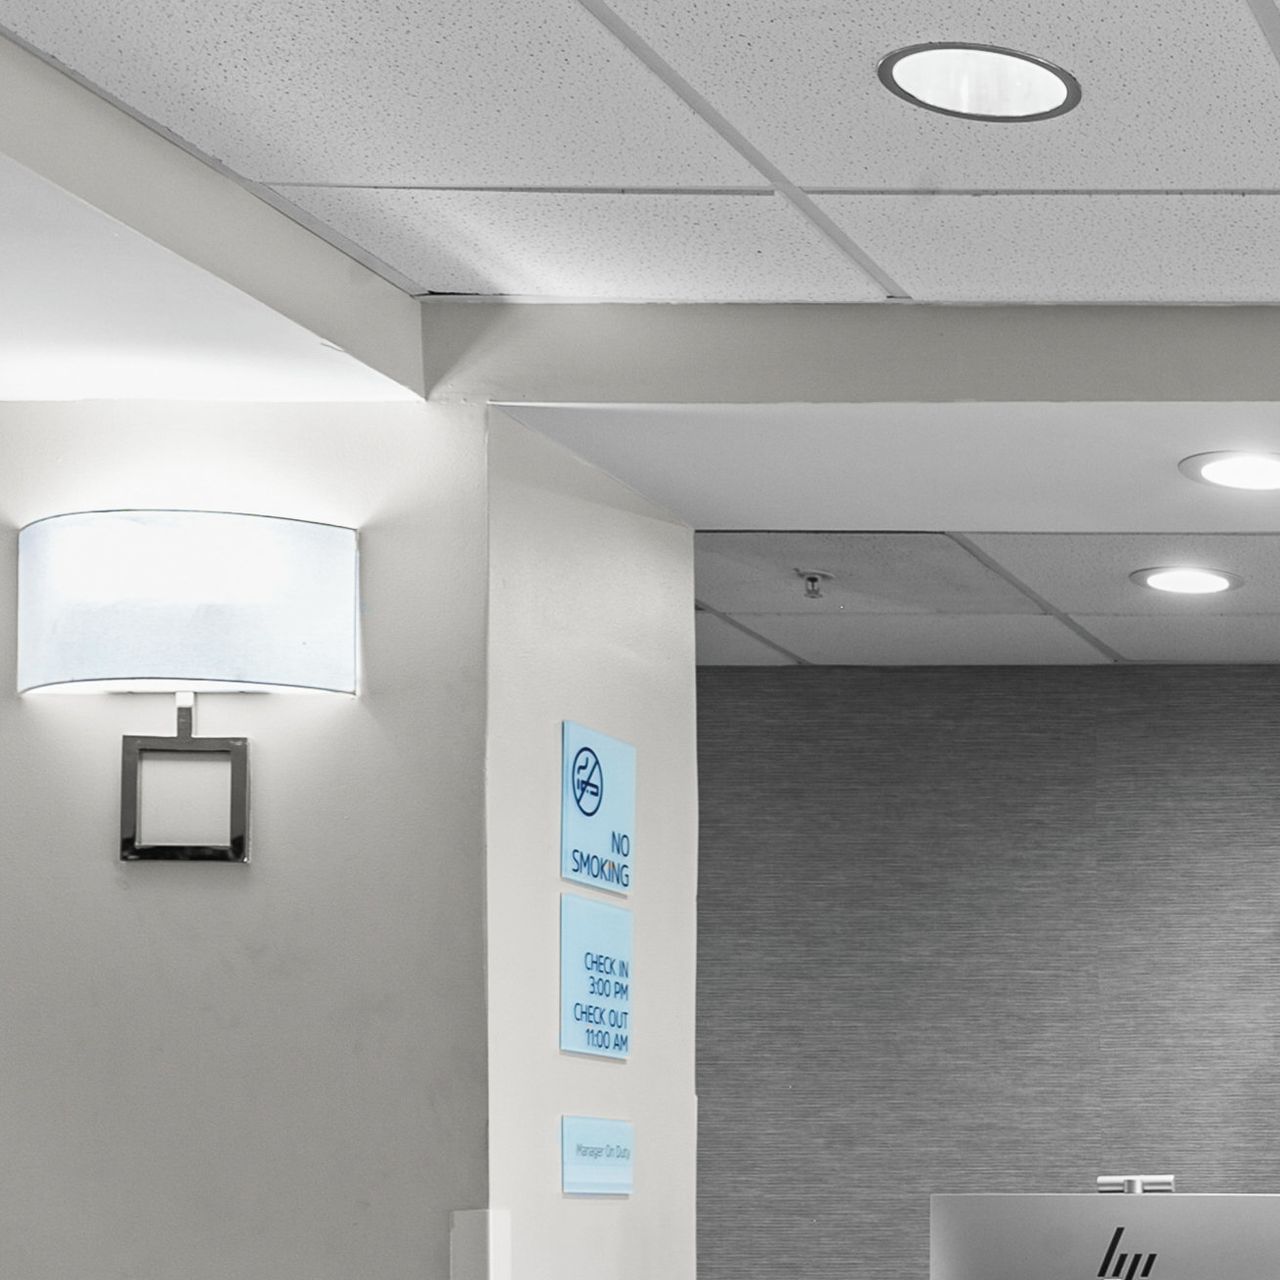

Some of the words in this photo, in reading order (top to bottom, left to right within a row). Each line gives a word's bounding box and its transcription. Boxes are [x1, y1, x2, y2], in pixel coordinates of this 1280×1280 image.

[611, 831, 630, 857] NO
[572, 849, 629, 887] SMOKING
[584, 952, 616, 976] CHECK
[618, 959, 629, 978] IN
[589, 976, 611, 997] 3:00
[613, 982, 629, 1000] PM
[573, 1003, 606, 1025] CHECK
[608, 1009, 629, 1029] OUT
[585, 1028, 610, 1049] 11:00
[613, 1034, 628, 1052] AM
